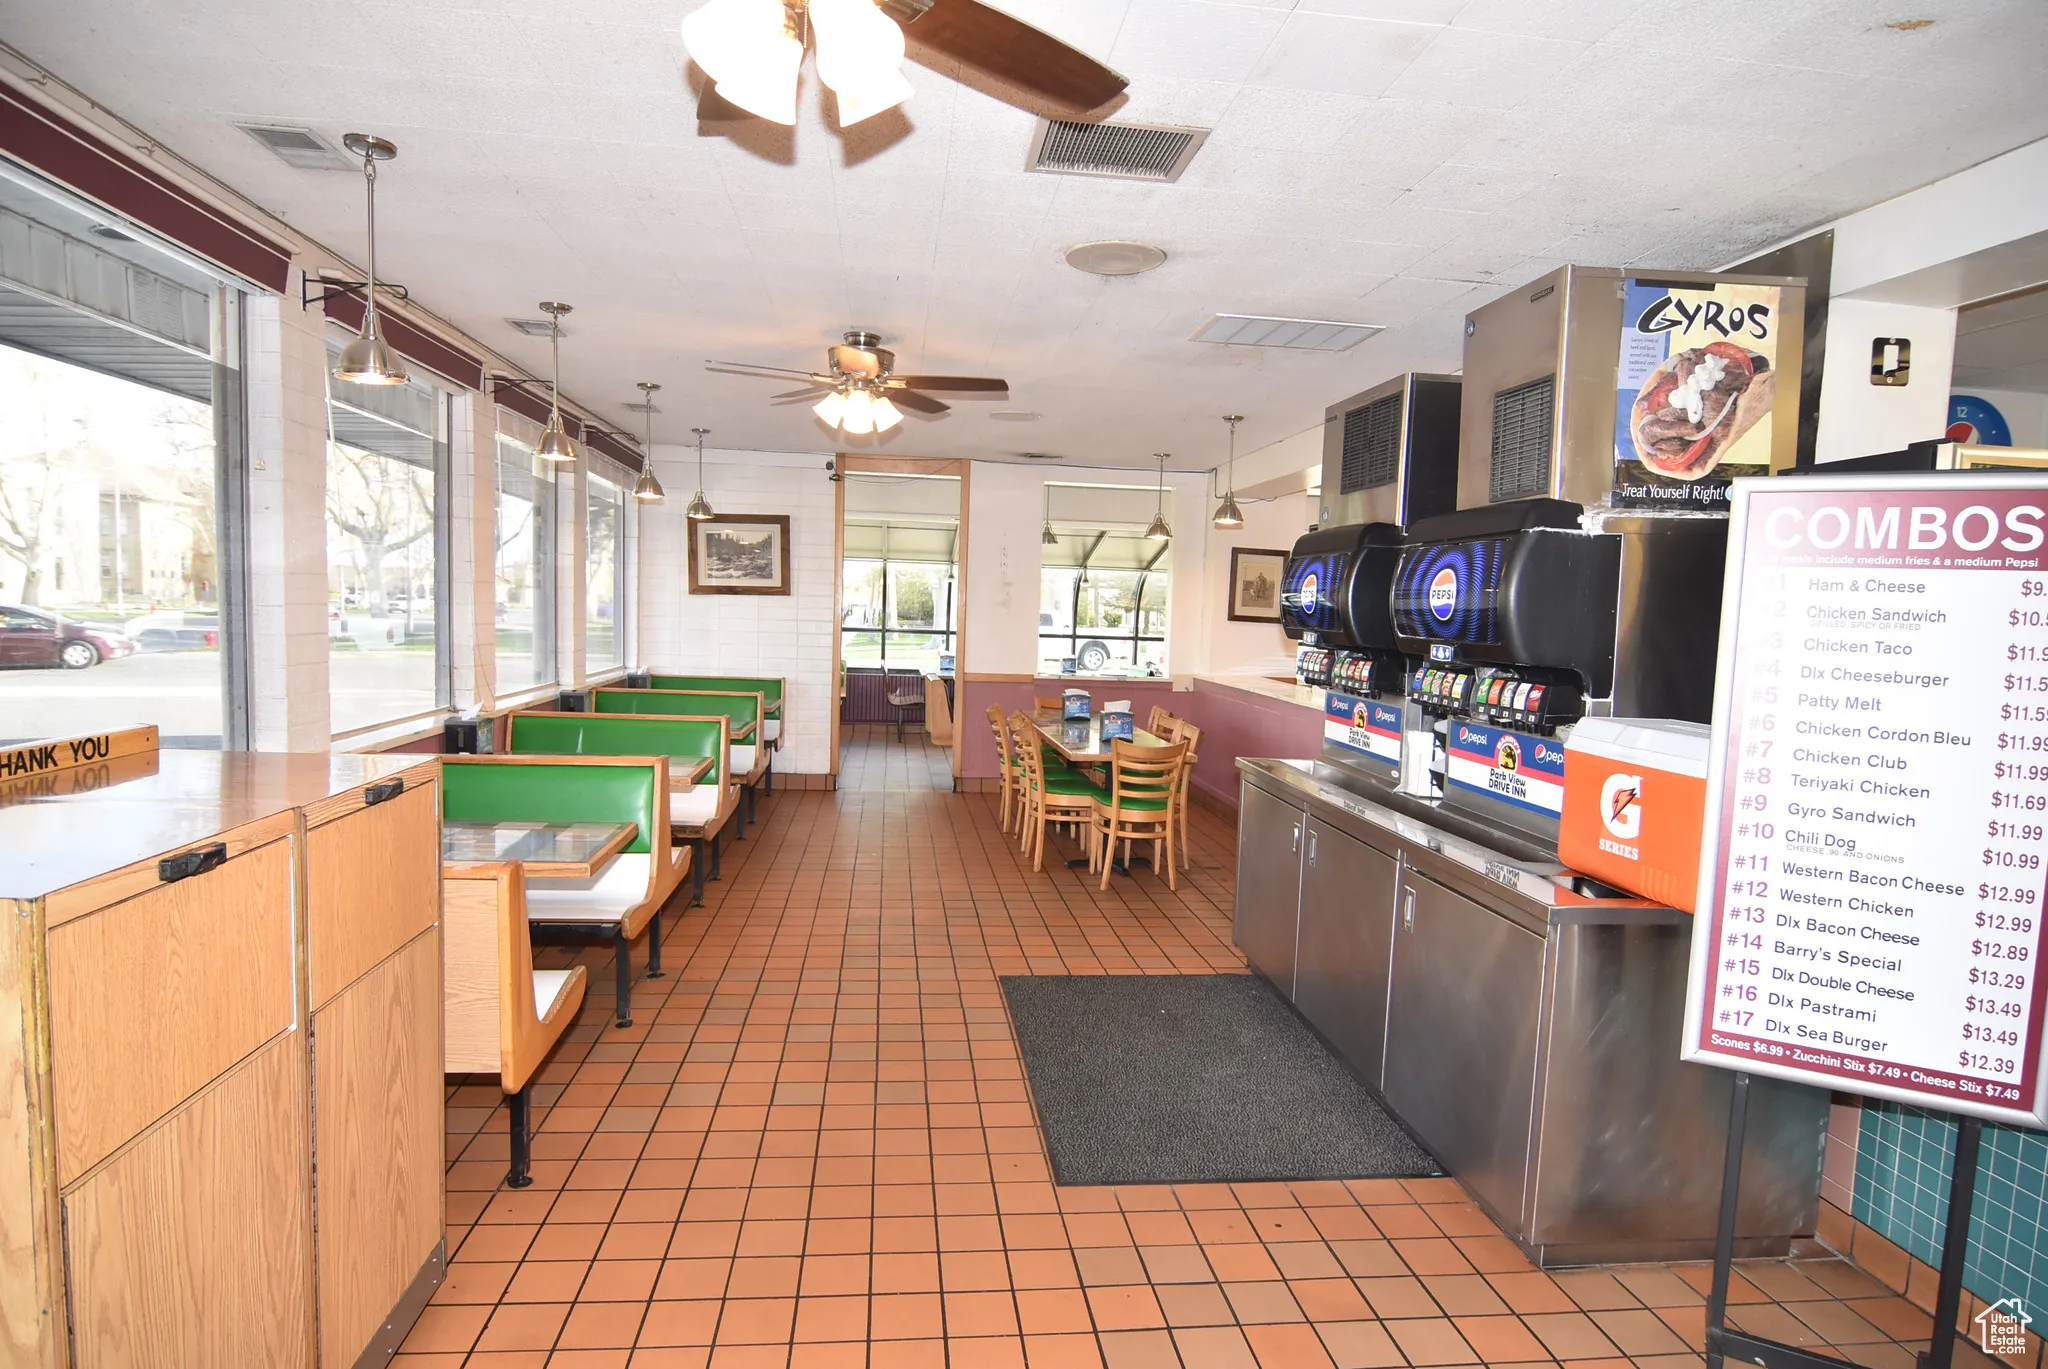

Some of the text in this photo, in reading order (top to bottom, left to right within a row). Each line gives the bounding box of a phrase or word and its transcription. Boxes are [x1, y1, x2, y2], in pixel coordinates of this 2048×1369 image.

[1637, 295, 1770, 339] GYROS
[1957, 407, 1968, 417] 12
[1622, 483, 1724, 504] Treat Yourself Right!
[1764, 505, 2046, 552] COMBOS
[1815, 555, 1854, 565] include
[1857, 556, 1903, 566] medium
[1905, 555, 1931, 566] fries
[1933, 557, 1941, 566] &
[1944, 558, 1951, 566] a
[1954, 557, 2001, 567] medium
[2005, 557, 2039, 569] Pepsi
[1432, 590, 1454, 599] PEPSI
[1809, 578, 1844, 593] Ham
[1849, 579, 1860, 592] &
[1865, 579, 1926, 594] Cheese
[2021, 578, 2048, 599] $9.
[1807, 606, 1866, 621] Chicken
[1871, 608, 1947, 624] Sandwich
[1879, 622, 1891, 630] OR
[1894, 622, 1921, 631] FRIED
[1804, 639, 1869, 654] Chicken
[1875, 641, 1912, 656] Taco
[2007, 643, 2048, 662] $11.9
[1800, 666, 1825, 680] Dlx
[1831, 668, 1949, 687] Cheeseburger
[2004, 673, 2048, 692] $11.5
[1337, 701, 1348, 710] pepsi
[1382, 712, 1396, 722] pepsi
[1752, 686, 2048, 722] #5 Patty Melt $11.5
[1349, 736, 1370, 749] DRIVE INN
[1468, 733, 1487, 745] pepsi
[1748, 714, 1775, 731] #6
[1795, 721, 1861, 738] Chicken
[1867, 726, 1929, 743] Cordon
[1933, 732, 1972, 746] Bleu
[0, 736, 109, 777] HANK YOU
[1546, 752, 1564, 765] pep
[1746, 741, 2048, 781] #7 Chicken Club $11.99
[1489, 779, 1526, 798] DRIVE INN
[1490, 768, 1526, 786] Park View
[1743, 768, 2046, 811] #8 Teriyaki Chicken $11.69
[1600, 773, 1642, 839] G
[1740, 794, 2043, 841] #9 Gyro Sandwich $11.99
[1599, 838, 1639, 860] SERIES
[1738, 823, 2040, 870] #10 Chili Dog $10.99
[1786, 844, 1824, 854] CHEESE
[1866, 853, 1904, 864] ONIONS
[1734, 855, 2035, 904] #11 Western Bacon Cheese $12.99
[1732, 881, 2032, 933] #12 Western Chicken $12.99
[1729, 907, 2028, 961] #13 Dlx Bacon Cheese $12.89
[1727, 933, 2025, 990] #14 Barry's Special $13.29
[1724, 959, 2022, 1018] #15 Dlx Double Cheese $13.49
[1722, 984, 2018, 1046] #16 Dlx Pastrami $13.49
[1719, 1010, 2015, 1074] #17 Dlx Sea Burger $12.39
[1711, 1033, 2020, 1101] Scones $6.99 Zucchini Stix $7.49 Cheese Stix $7.49
